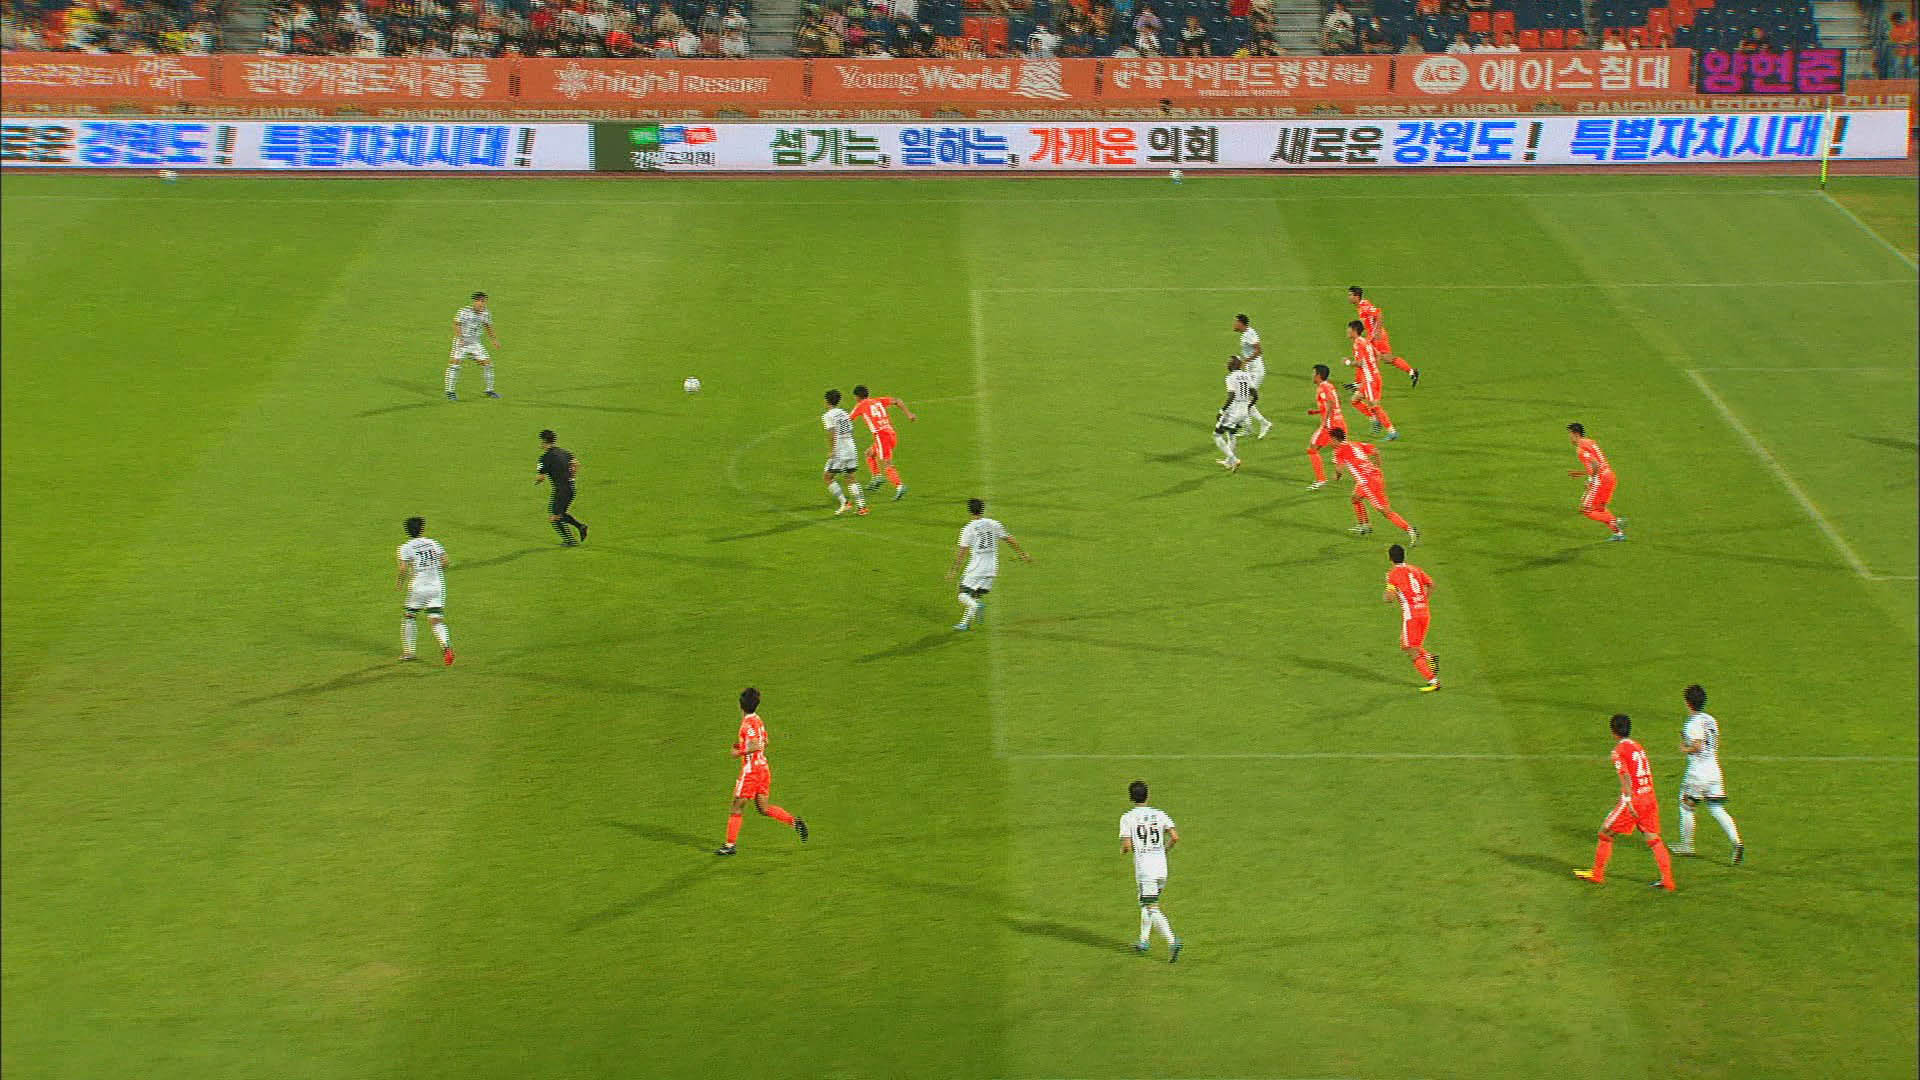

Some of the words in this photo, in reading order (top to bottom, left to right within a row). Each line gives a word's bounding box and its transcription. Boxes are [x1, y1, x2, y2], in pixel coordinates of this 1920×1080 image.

[421, 61, 491, 97] 강릉
[682, 74, 771, 94] RESORT
[1140, 59, 1330, 88] 유나이티드병원
[1421, 64, 1460, 82] ACE
[1478, 55, 1671, 92] 에이스침대
[1702, 50, 1841, 94] 양현준
[769, 126, 890, 168] 섬기는,
[898, 126, 1018, 168] 일하는,
[1028, 126, 1139, 165] 가까운
[1147, 126, 1219, 164] 의회
[1269, 125, 1383, 164] 새로운
[1238, 381, 1248, 399] 11
[1408, 572, 1421, 594] 6
[1136, 821, 1160, 848] 95
